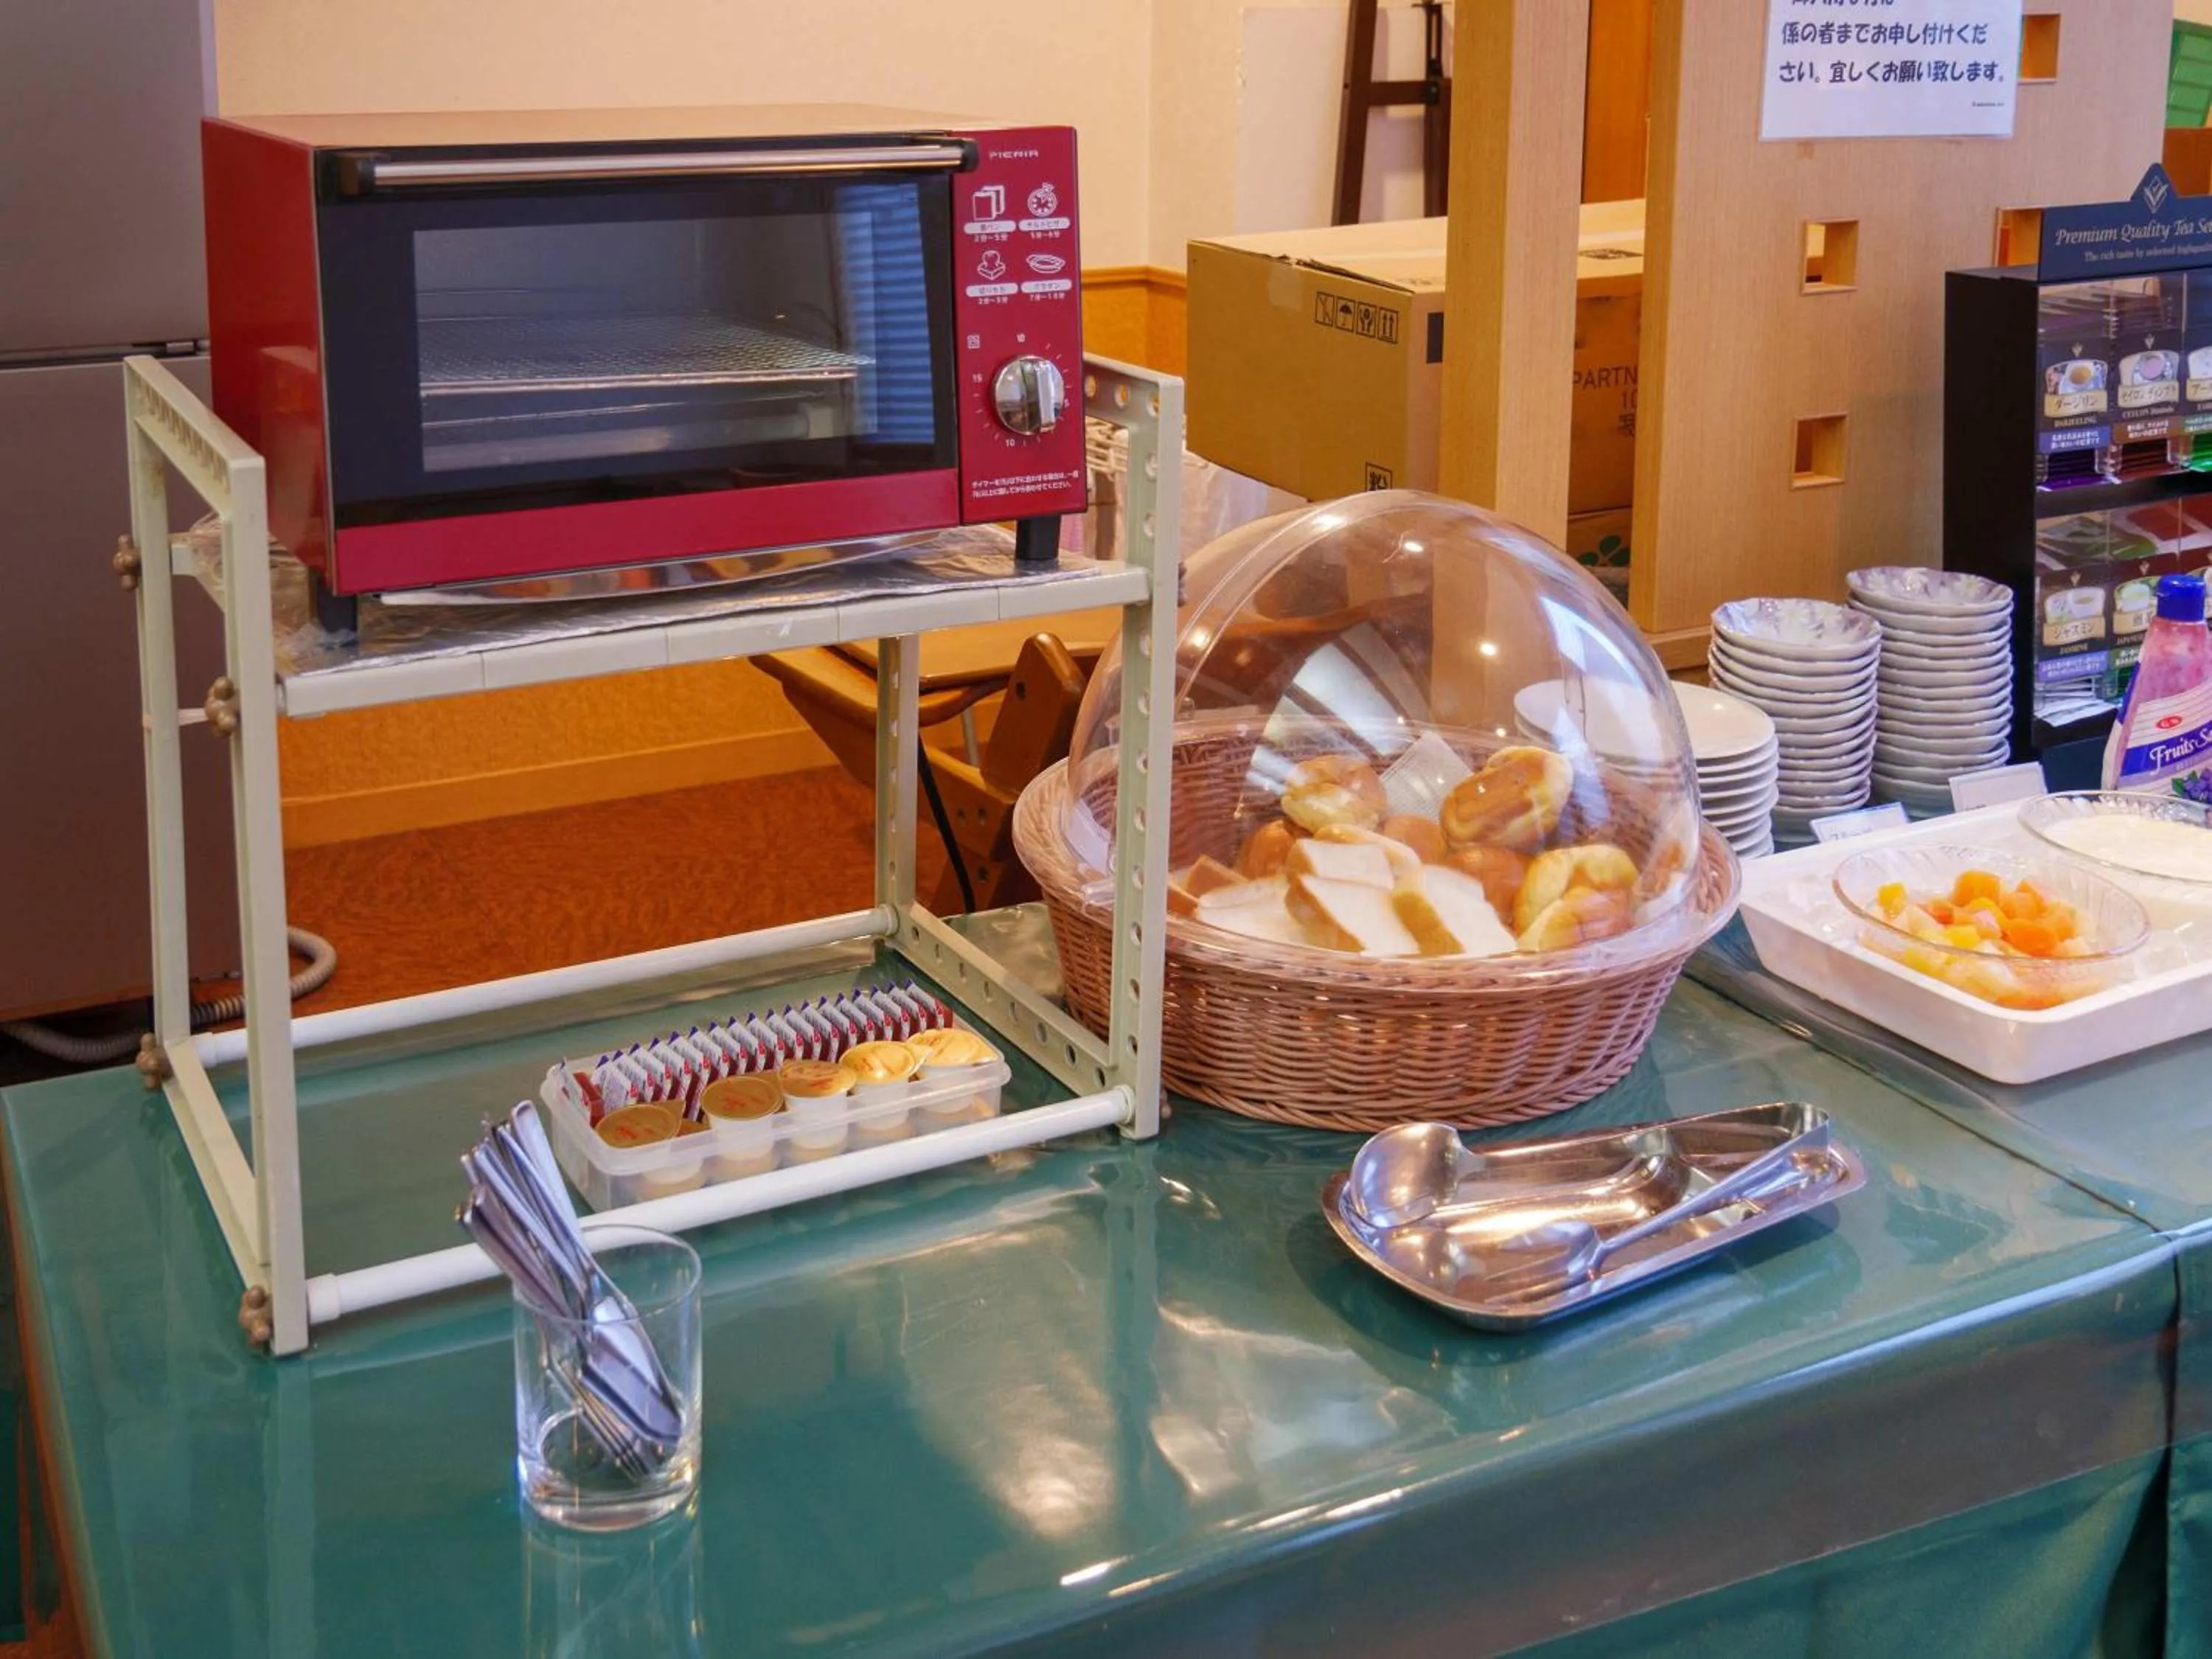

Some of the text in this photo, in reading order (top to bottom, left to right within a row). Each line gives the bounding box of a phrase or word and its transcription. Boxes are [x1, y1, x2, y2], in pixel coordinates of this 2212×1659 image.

[1782, 22, 1989, 45] 係の者までお申し付けくだ
[1779, 60, 2004, 83] さい。宜しくお願い致します。
[2055, 229, 2117, 246] Premium
[2121, 220, 2170, 243] Quality
[2174, 219, 2194, 236] Tea
[972, 374, 982, 382] 15
[1064, 399, 1070, 407] 5
[1006, 439, 1015, 447] 10
[2149, 737, 2196, 775] Fruits
[2196, 727, 2212, 748] S
